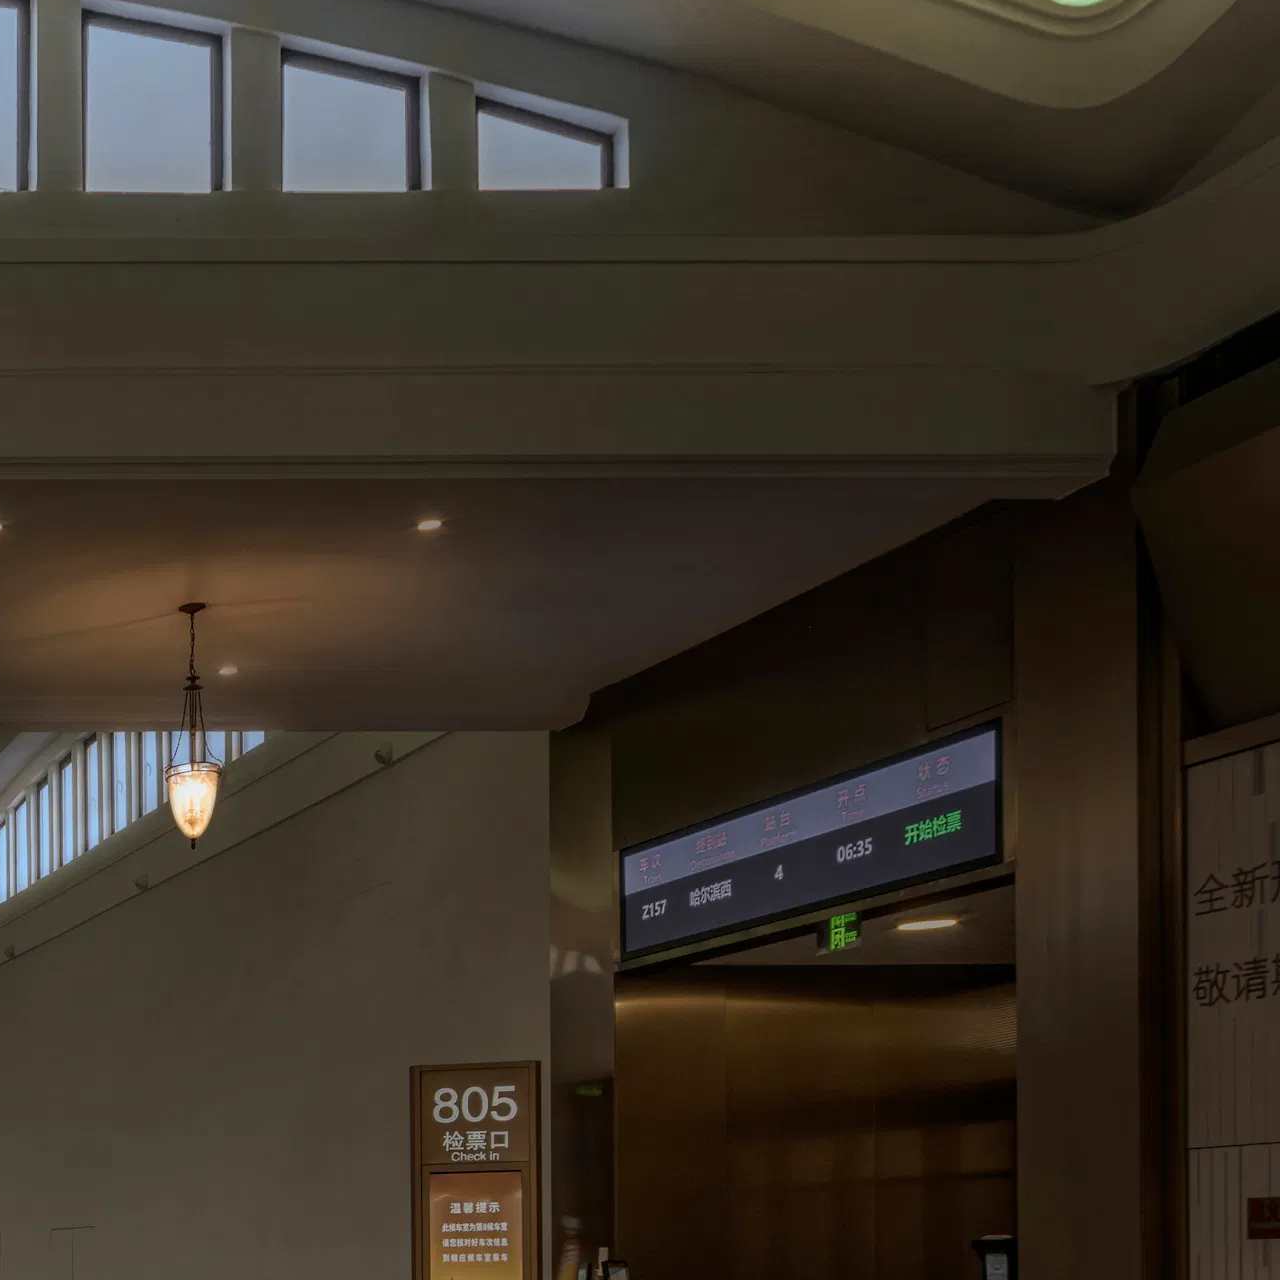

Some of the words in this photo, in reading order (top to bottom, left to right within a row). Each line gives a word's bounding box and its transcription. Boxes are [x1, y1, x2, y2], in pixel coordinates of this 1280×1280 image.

[837, 783, 866, 808] 开点
[917, 755, 952, 781] 状态
[641, 898, 668, 921] Z157
[689, 879, 733, 908] 哈尔滨西
[774, 864, 784, 880] 4
[836, 837, 873, 864] 06:35
[903, 810, 963, 846] 开始检票
[1193, 860, 1280, 916] 全新
[1193, 954, 1280, 1007] 敬请
[432, 1085, 518, 1124] 805
[442, 1130, 509, 1151] 检票口
[451, 1151, 487, 1162] Check
[489, 1151, 500, 1161] in
[450, 1201, 500, 1214] 温馨提示
